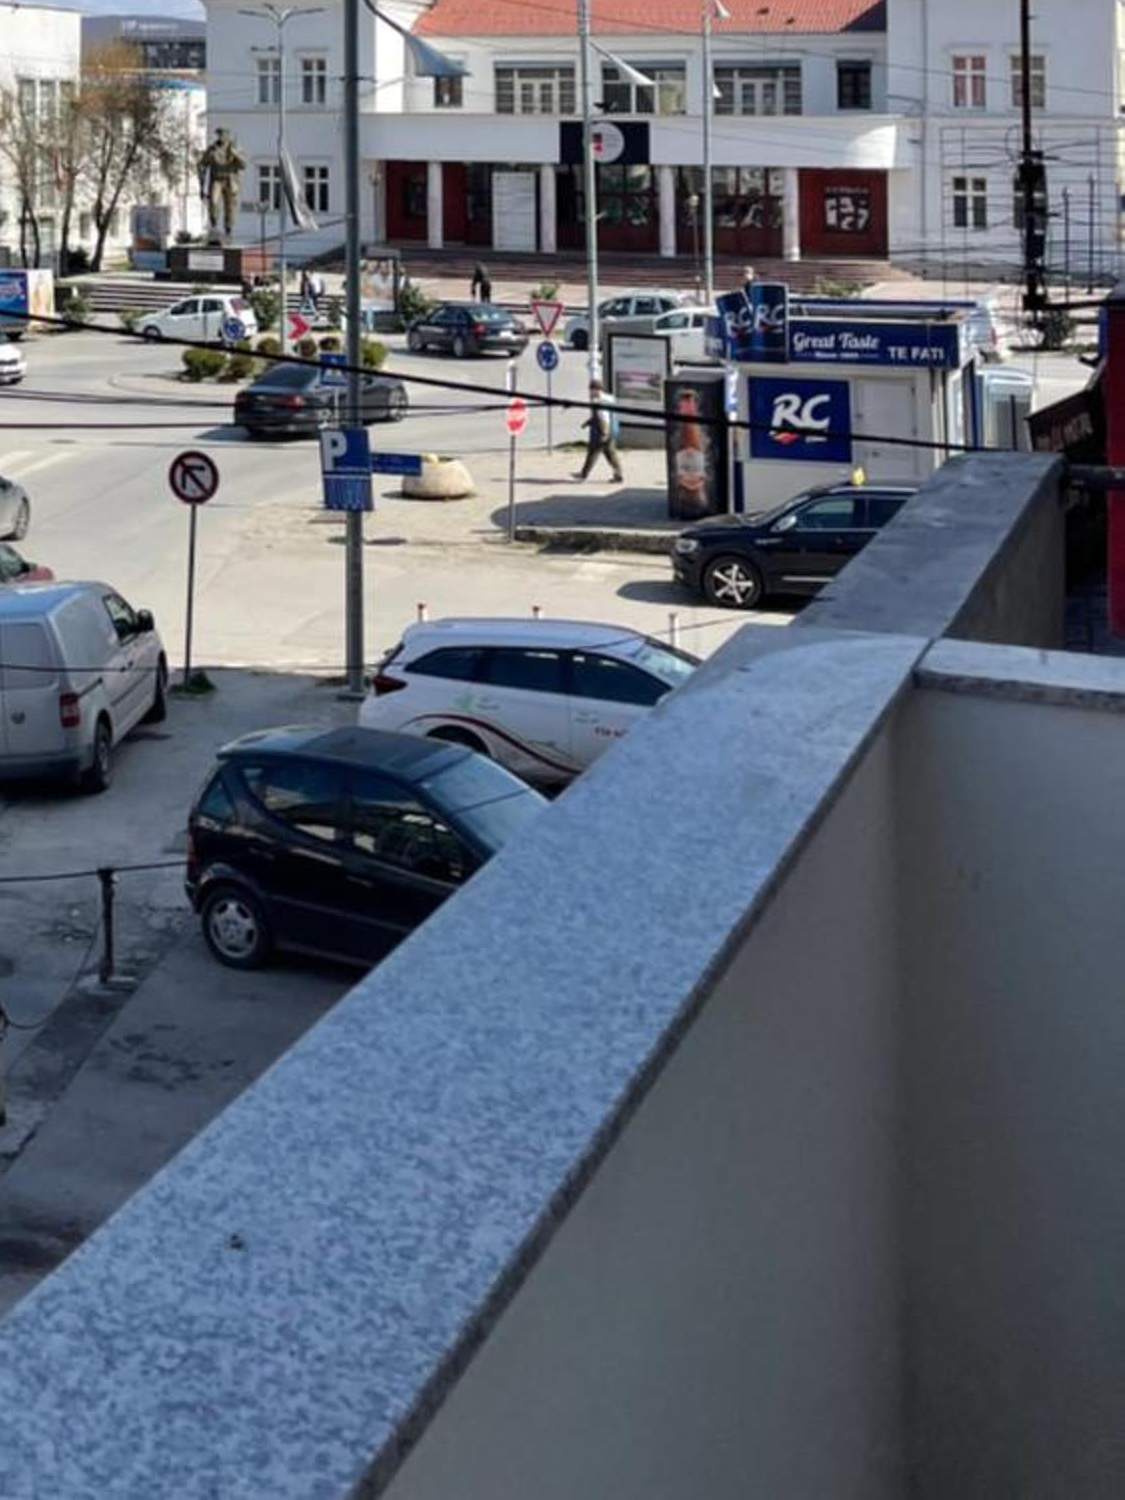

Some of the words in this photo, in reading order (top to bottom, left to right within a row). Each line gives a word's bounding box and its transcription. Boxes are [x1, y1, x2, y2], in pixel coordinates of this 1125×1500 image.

[793, 331, 835, 352] Great
[838, 331, 880, 349] Taste
[772, 393, 831, 429] RC
[321, 430, 348, 471] P
